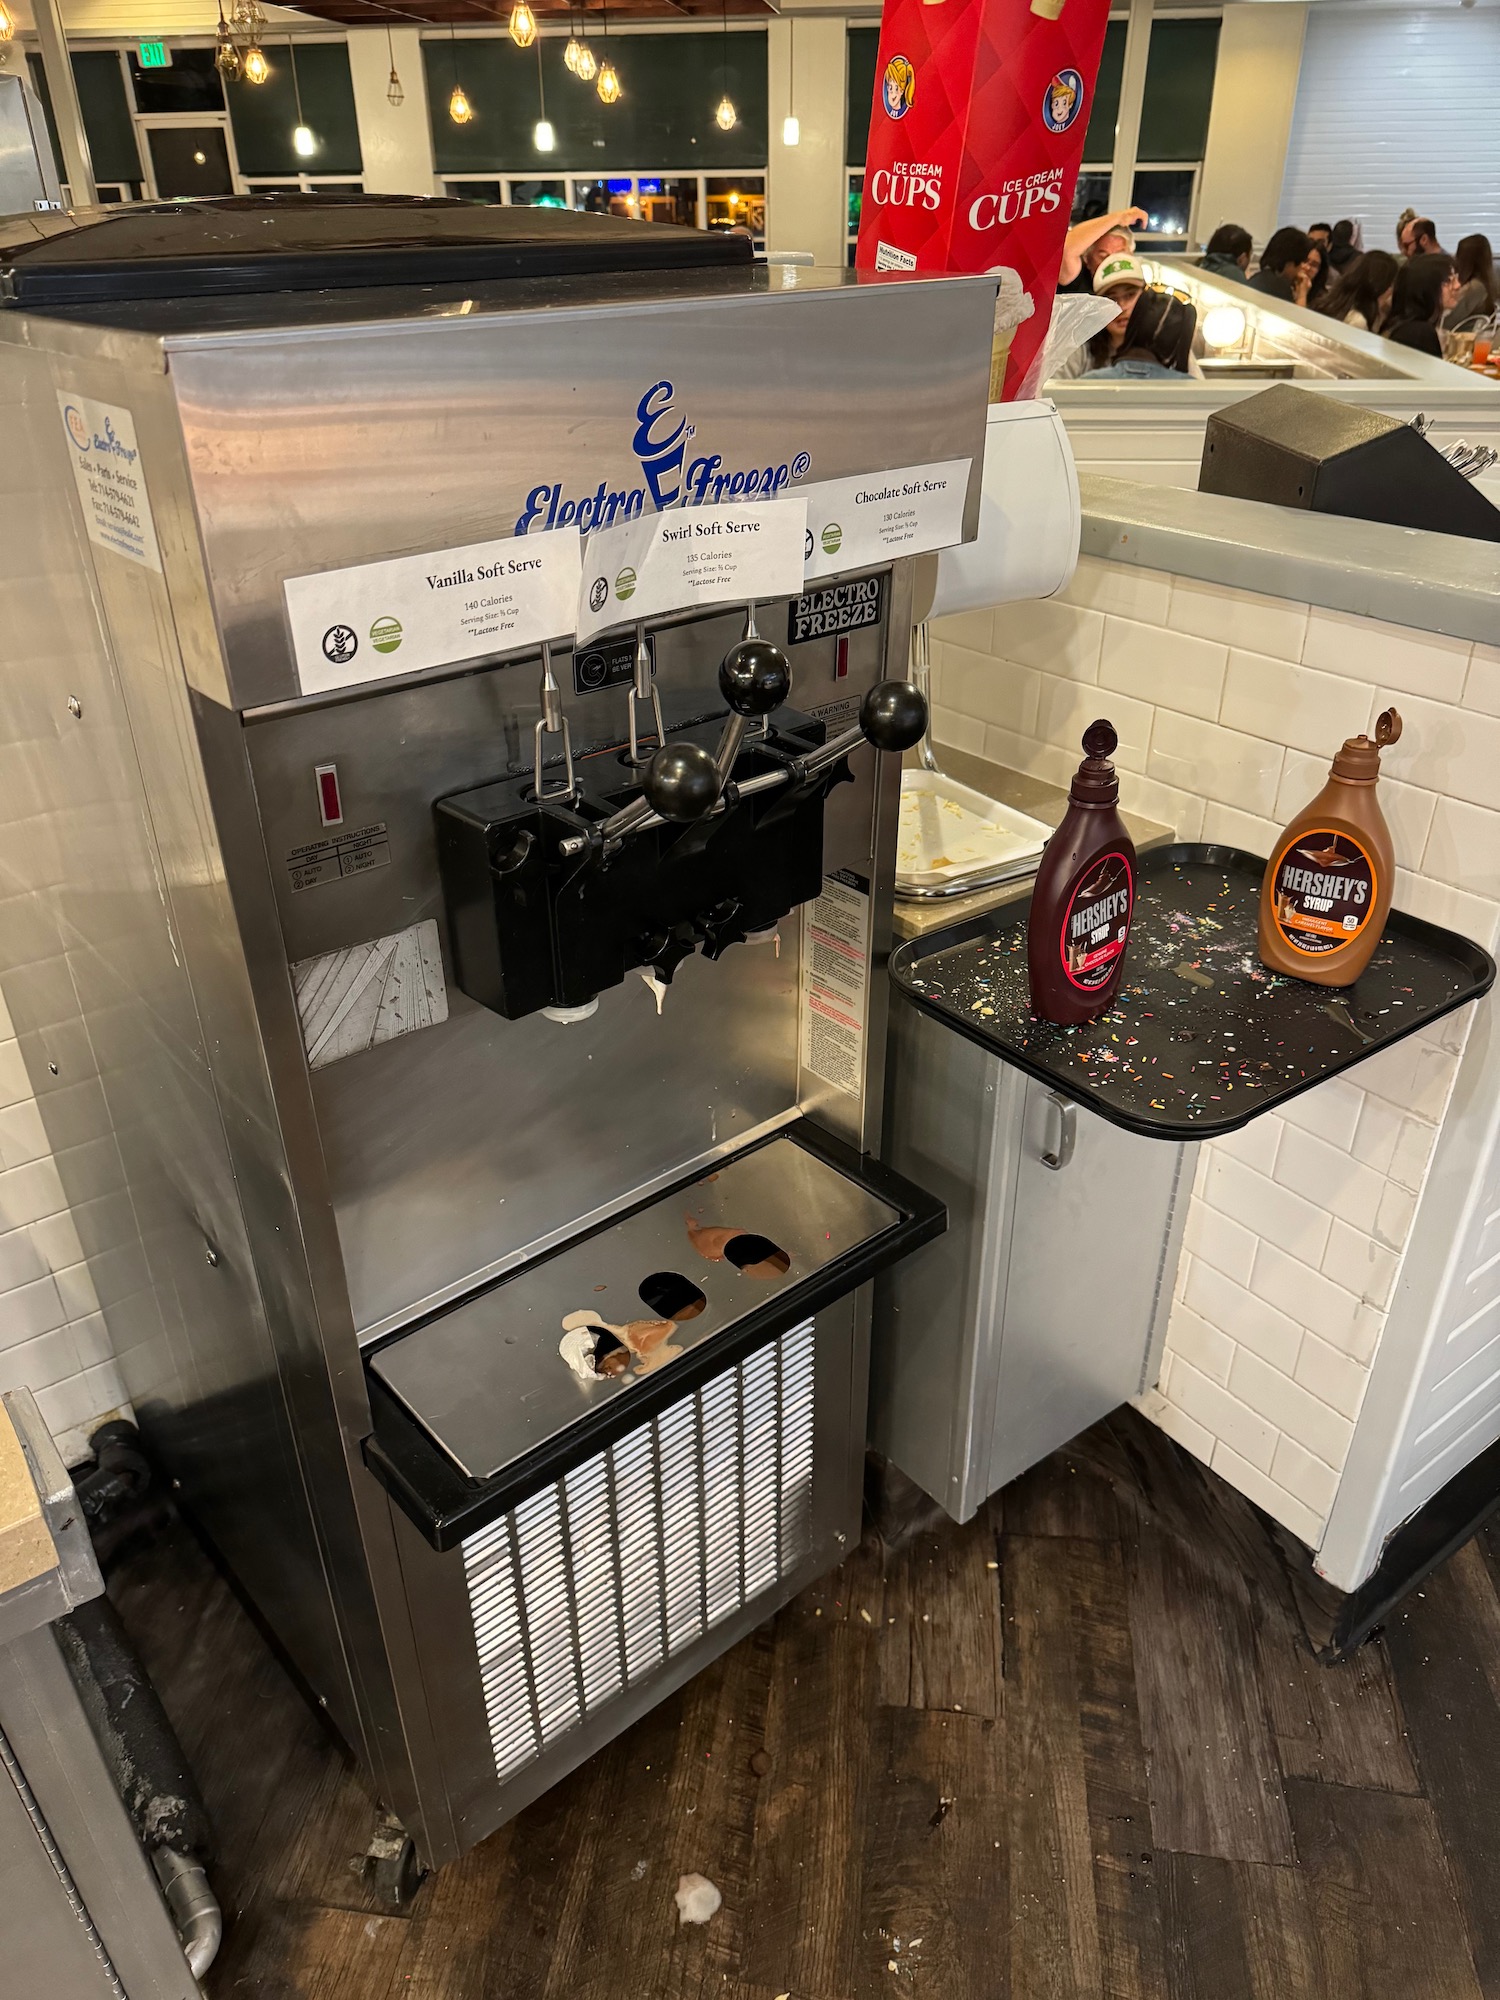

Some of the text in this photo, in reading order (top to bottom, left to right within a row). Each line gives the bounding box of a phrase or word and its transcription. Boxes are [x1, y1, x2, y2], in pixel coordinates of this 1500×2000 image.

[140, 42, 166, 67] EXIT
[892, 161, 943, 178] ICE CREAM
[1002, 167, 1064, 194] ICE CREAM
[871, 169, 942, 211] CUPS
[968, 181, 1063, 231] CUPS
[855, 480, 947, 505] Chocolate Soft Serve
[883, 510, 916, 522] 130 Calories
[662, 520, 760, 542] Swirl Soft Serve
[879, 526, 895, 534] Serving
[687, 550, 732, 563] 135 Calories
[426, 558, 542, 590] Vanilla Soft Serve
[682, 568, 702, 577] Serving
[724, 563, 738, 571] Cup
[717, 576, 731, 584] Free
[464, 594, 513, 611] 140 Calories
[795, 578, 879, 617] ELECTRO
[460, 616, 484, 626] Serving
[484, 612, 499, 621] Size:
[506, 608, 519, 616] Cup
[795, 600, 877, 640] FREEZE
[500, 622, 515, 631] Free
[611, 655, 628, 665] FLATS
[817, 701, 850, 717] WARNING
[291, 825, 380, 856] OPERATING INSTRUCTIONS
[353, 838, 373, 849] NIGHT
[305, 854, 319, 863] DAY
[354, 851, 373, 861] AUTO
[356, 859, 376, 870] NIGHT
[303, 866, 322, 876] AUTO
[305, 877, 318, 886] DAY
[1281, 864, 1368, 905] HERSHEY'S
[1302, 895, 1334, 913] SYRUP
[1071, 888, 1128, 939] HERSHEY'S
[1090, 922, 1110, 945] SYRUP
[1294, 919, 1316, 929] CARAMEL
[1315, 924, 1334, 932] FLAVOR
